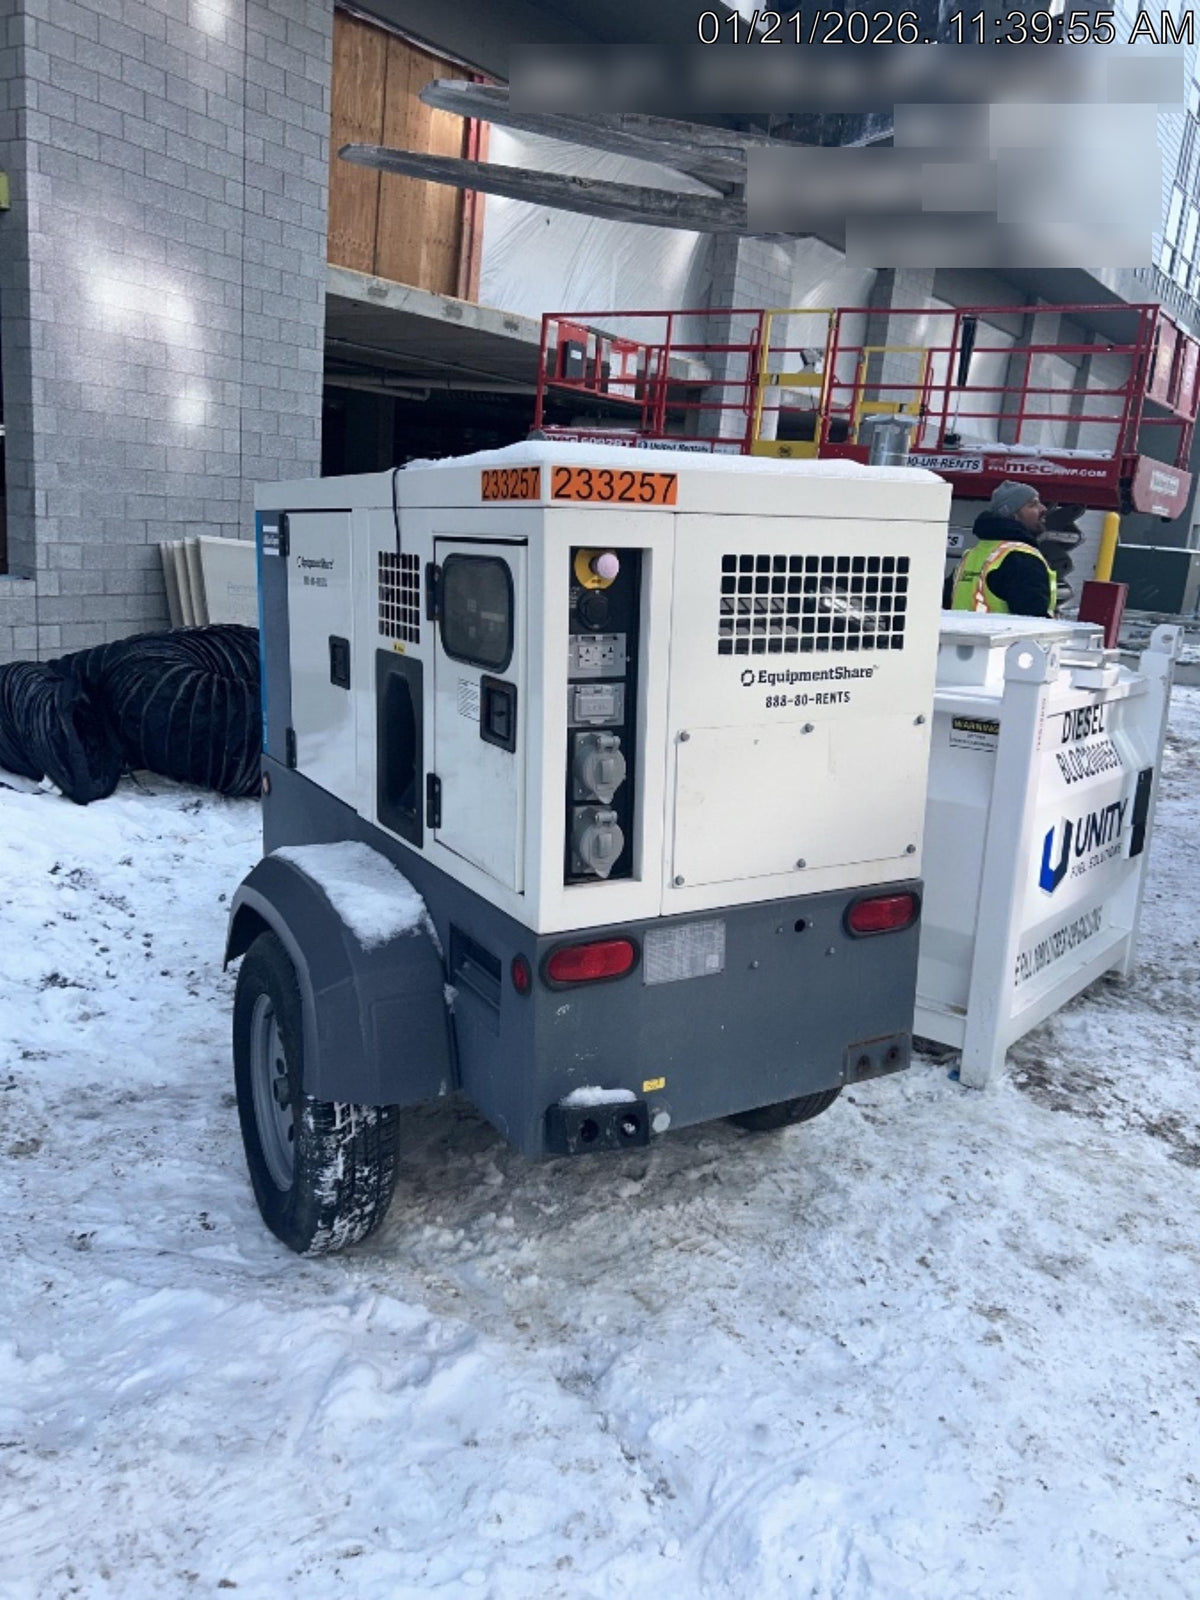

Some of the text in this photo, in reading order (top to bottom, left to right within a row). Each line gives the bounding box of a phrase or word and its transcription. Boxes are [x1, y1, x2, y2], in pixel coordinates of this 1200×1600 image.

[483, 467, 541, 499] 233257
[554, 467, 677, 502] 233257
[758, 665, 874, 686] EquipmentShare
[765, 691, 851, 708] 888-80-RENTS
[1061, 703, 1105, 744] DIESEL
[1075, 797, 1129, 858] UNITY
